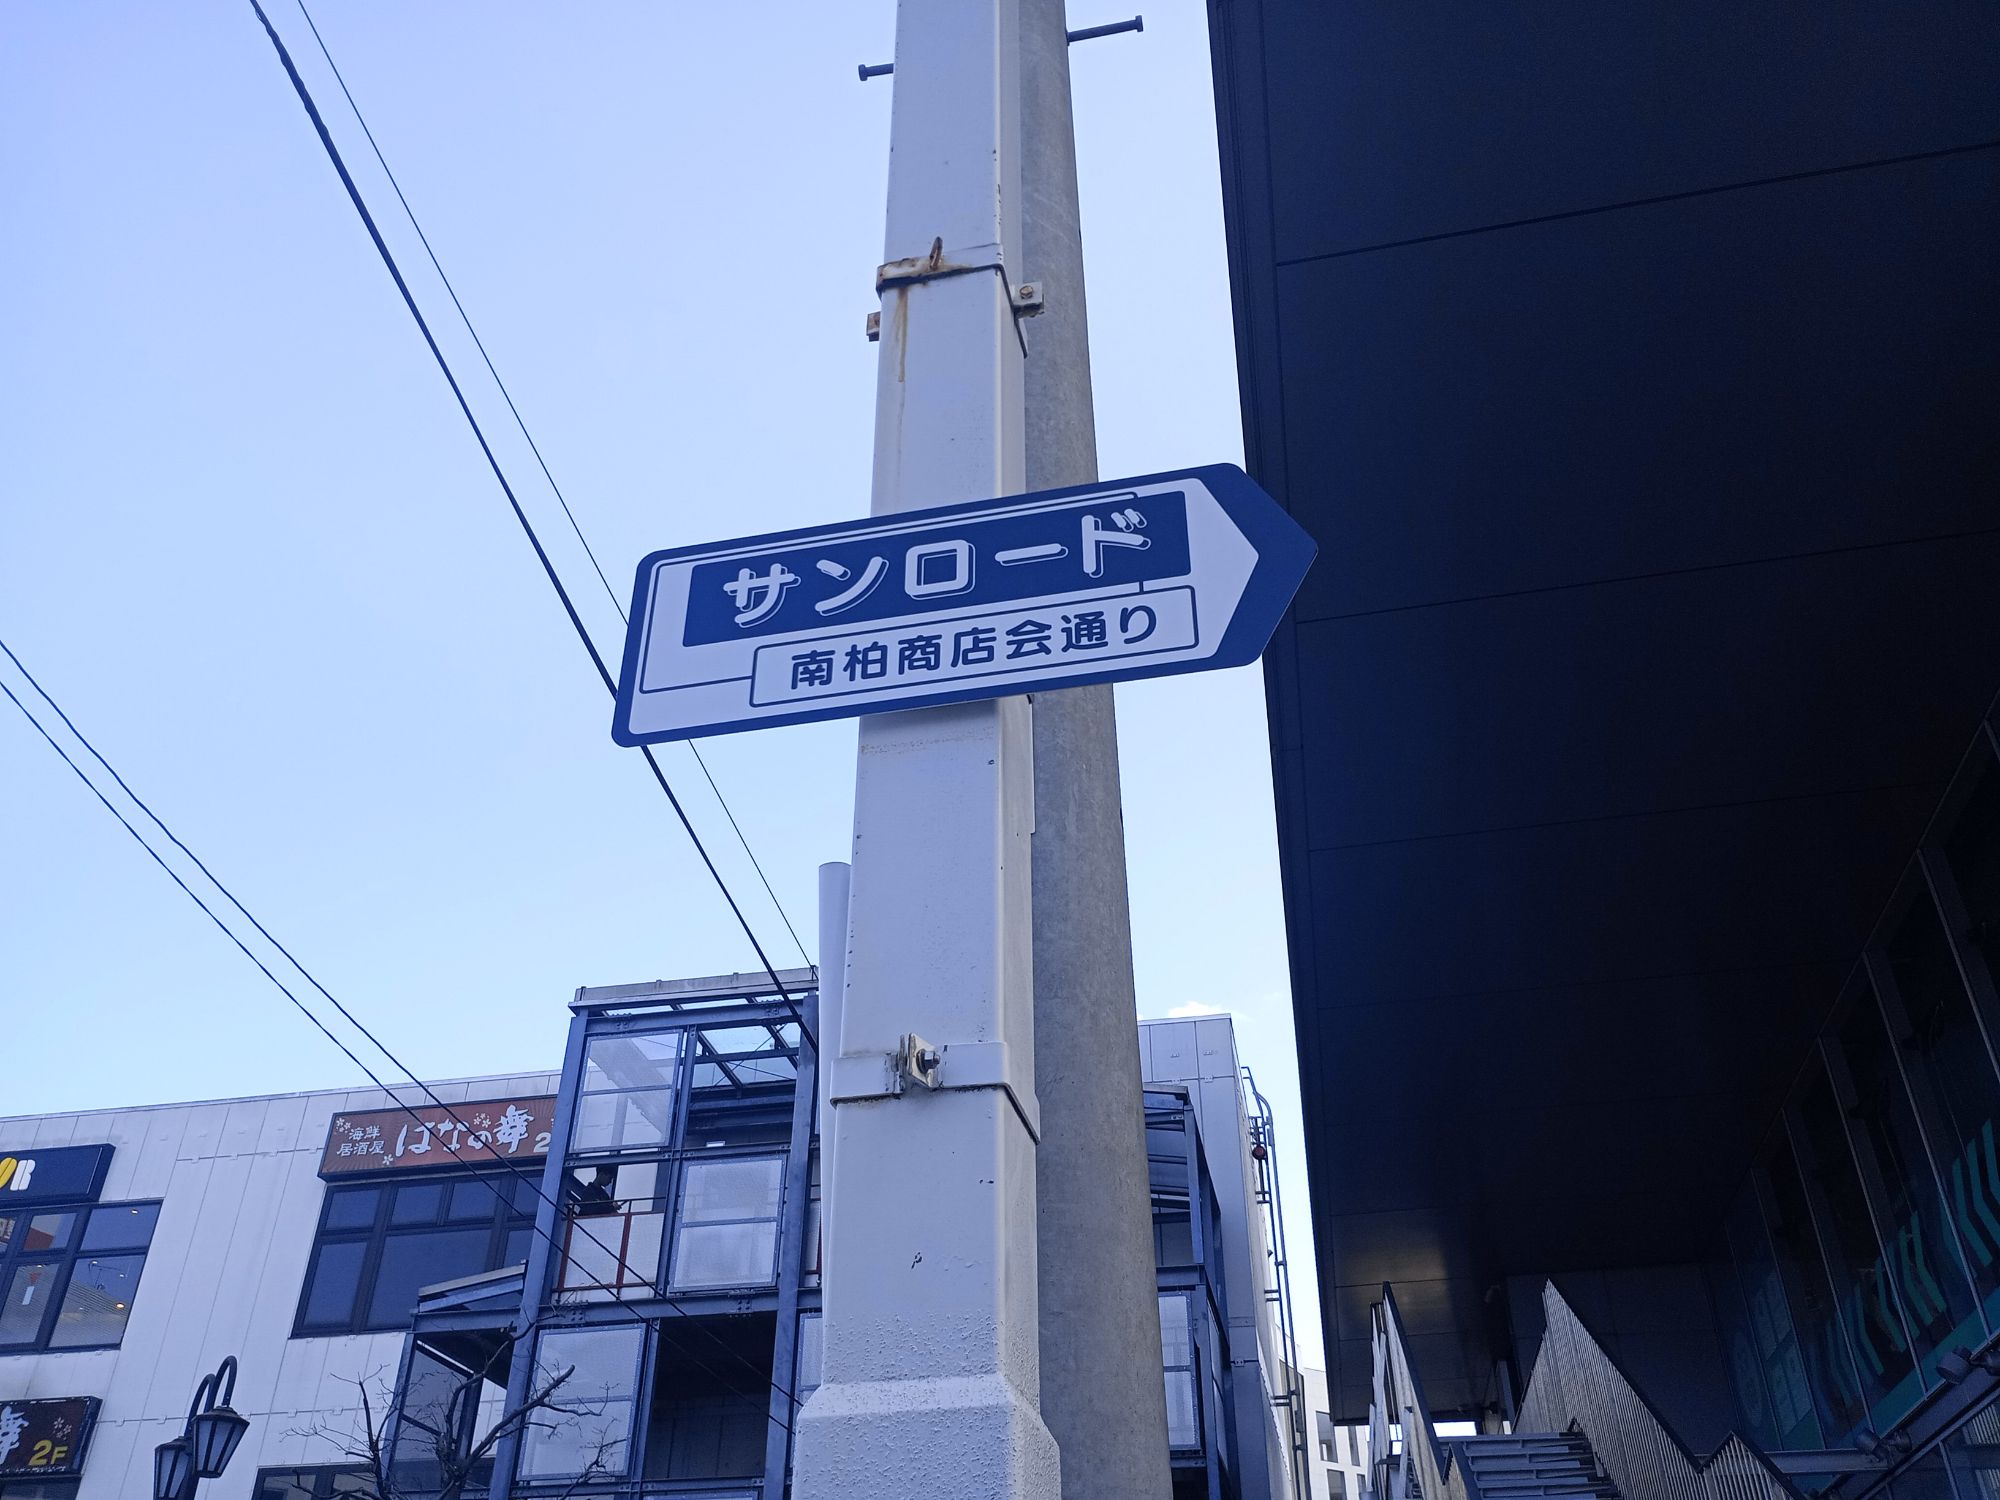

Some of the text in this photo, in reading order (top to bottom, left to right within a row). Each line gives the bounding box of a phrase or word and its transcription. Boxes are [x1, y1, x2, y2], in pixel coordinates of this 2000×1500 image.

[724, 508, 1150, 628] サンロード
[791, 606, 1158, 690] 南柏商店会通り
[336, 1140, 385, 1158] 居酒屋
[348, 1124, 381, 1142] 海鮮
[395, 1104, 535, 1157] はなの舞
[28, 1439, 69, 1466] 2F
